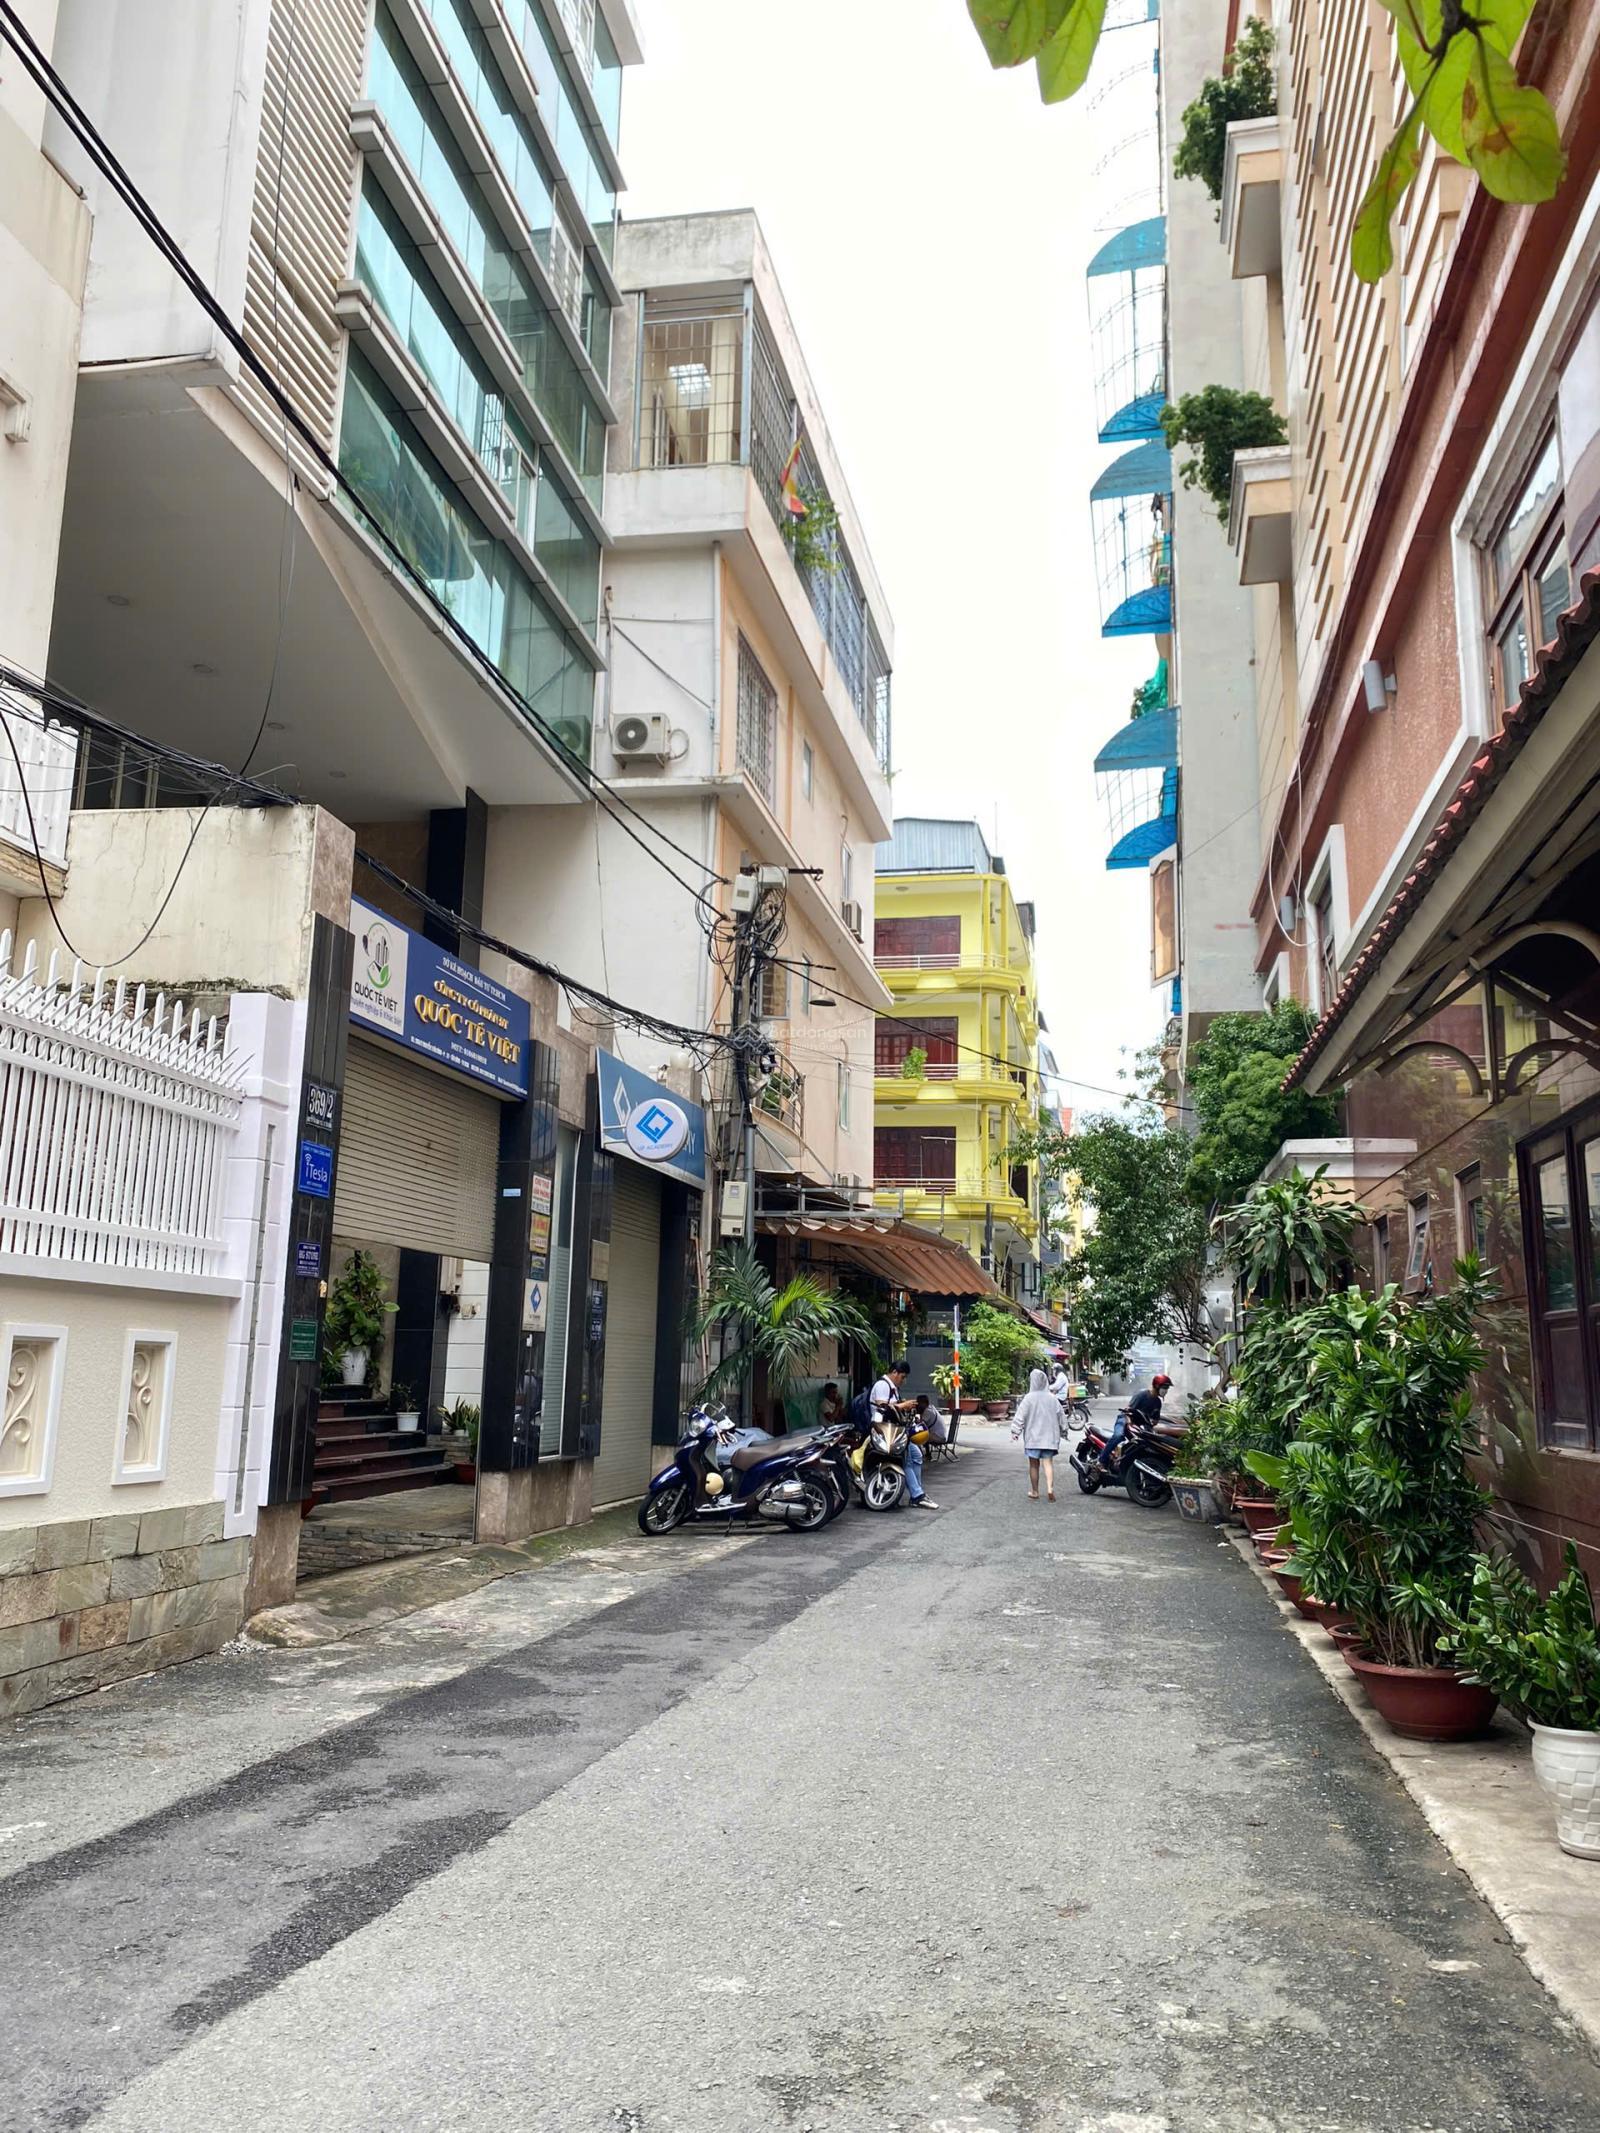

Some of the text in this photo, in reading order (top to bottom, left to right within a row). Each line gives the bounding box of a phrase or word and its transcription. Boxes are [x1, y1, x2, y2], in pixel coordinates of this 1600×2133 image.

[374, 990, 382, 1005] TẾ
[382, 996, 398, 1012] VIỆT
[414, 993, 463, 1034] QUỐC
[464, 1018, 485, 1046] TẾ
[486, 1031, 520, 1064] VIỆT
[309, 1088, 334, 1120] 369/2
[305, 1161, 328, 1183] iTesla
